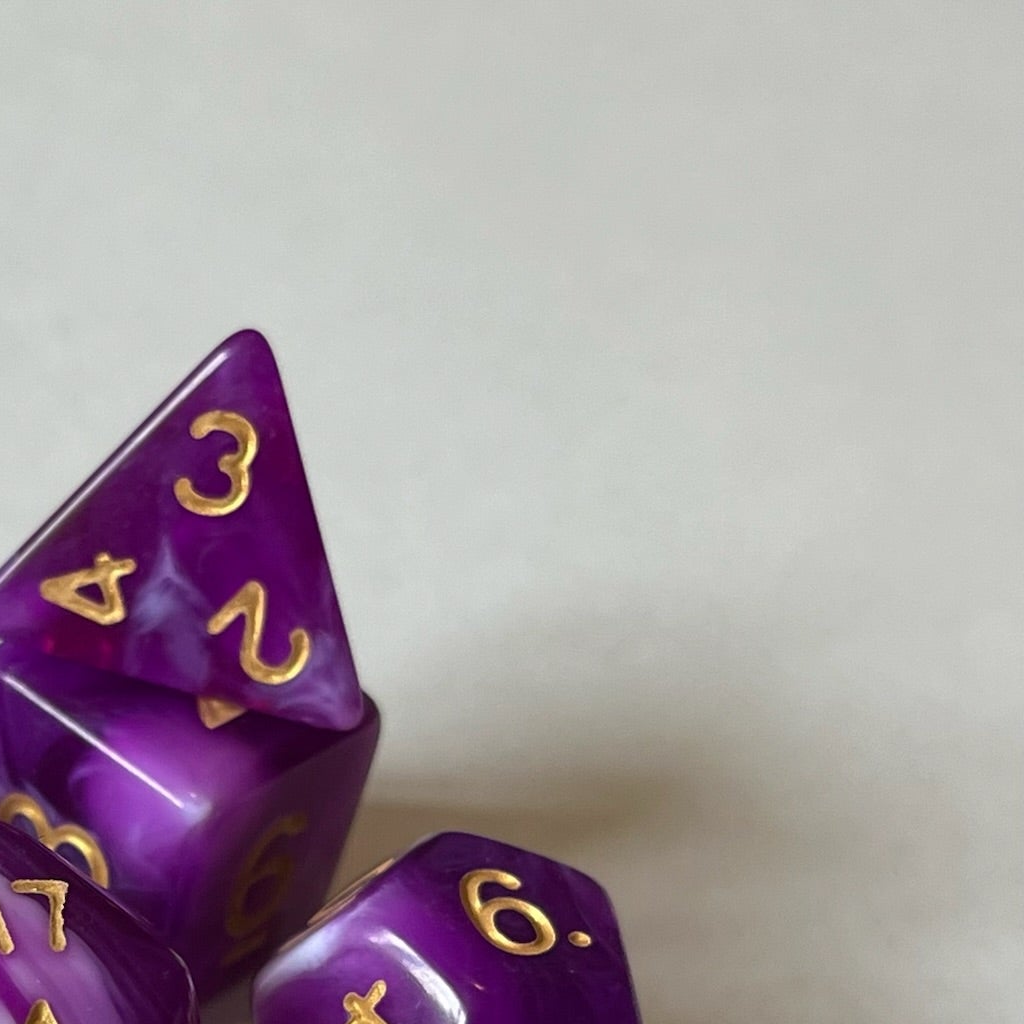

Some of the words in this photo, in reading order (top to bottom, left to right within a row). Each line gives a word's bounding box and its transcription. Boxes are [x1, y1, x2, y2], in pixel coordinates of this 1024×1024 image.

[175, 410, 258, 517] 3
[40, 552, 136, 625] 4
[207, 581, 310, 685] 2
